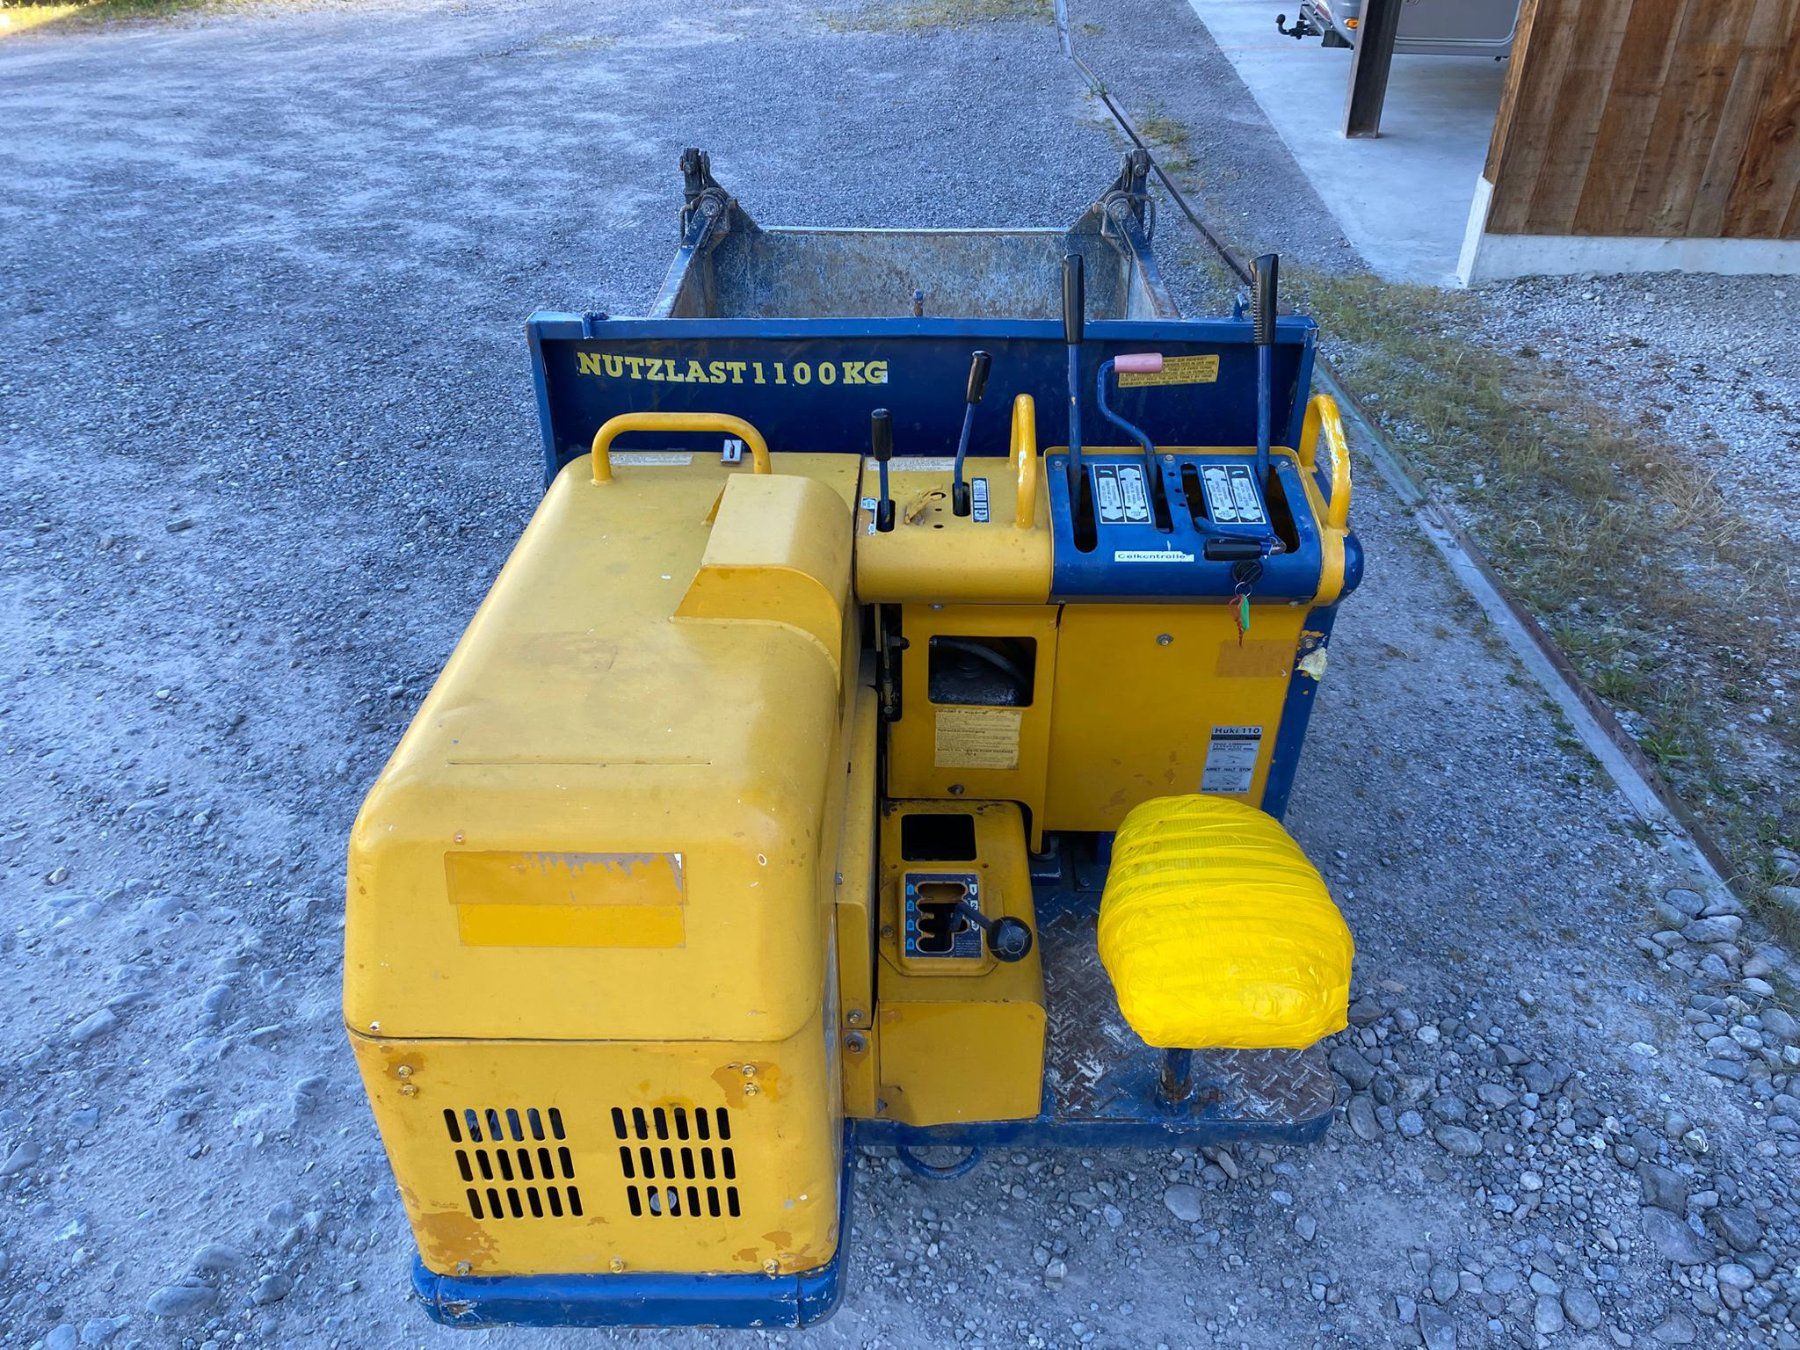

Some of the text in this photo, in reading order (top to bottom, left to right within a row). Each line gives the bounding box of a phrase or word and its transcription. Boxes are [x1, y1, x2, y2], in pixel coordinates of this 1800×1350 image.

[577, 351, 889, 385] NUTZLAST 1100 KG
